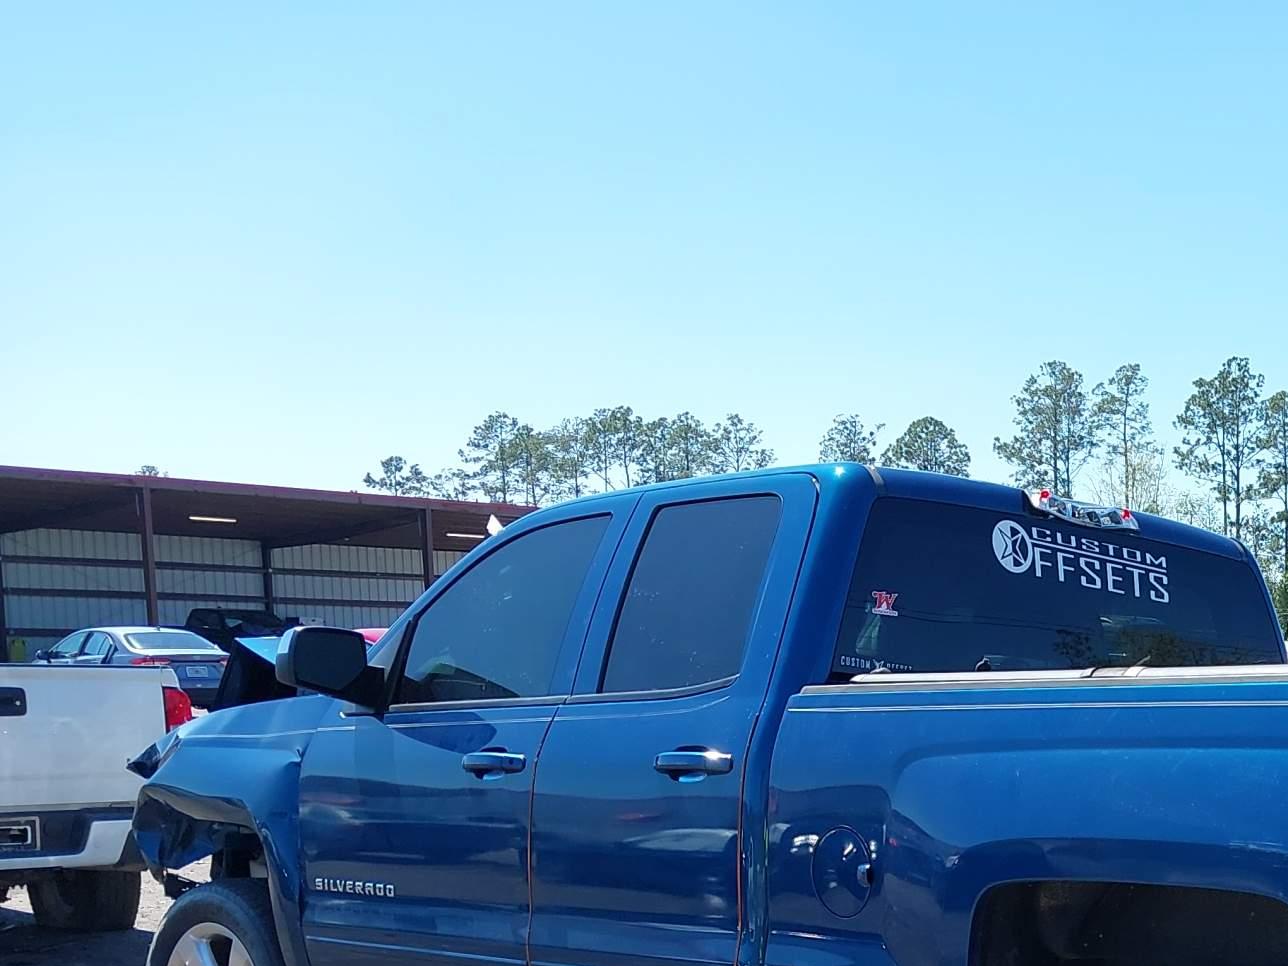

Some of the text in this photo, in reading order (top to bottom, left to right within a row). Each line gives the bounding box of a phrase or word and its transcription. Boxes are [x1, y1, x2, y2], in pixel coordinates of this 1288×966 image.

[1031, 526, 1167, 569] CUSTOM
[840, 655, 871, 669] CUSTOM
[315, 878, 395, 897] SILVERADO
